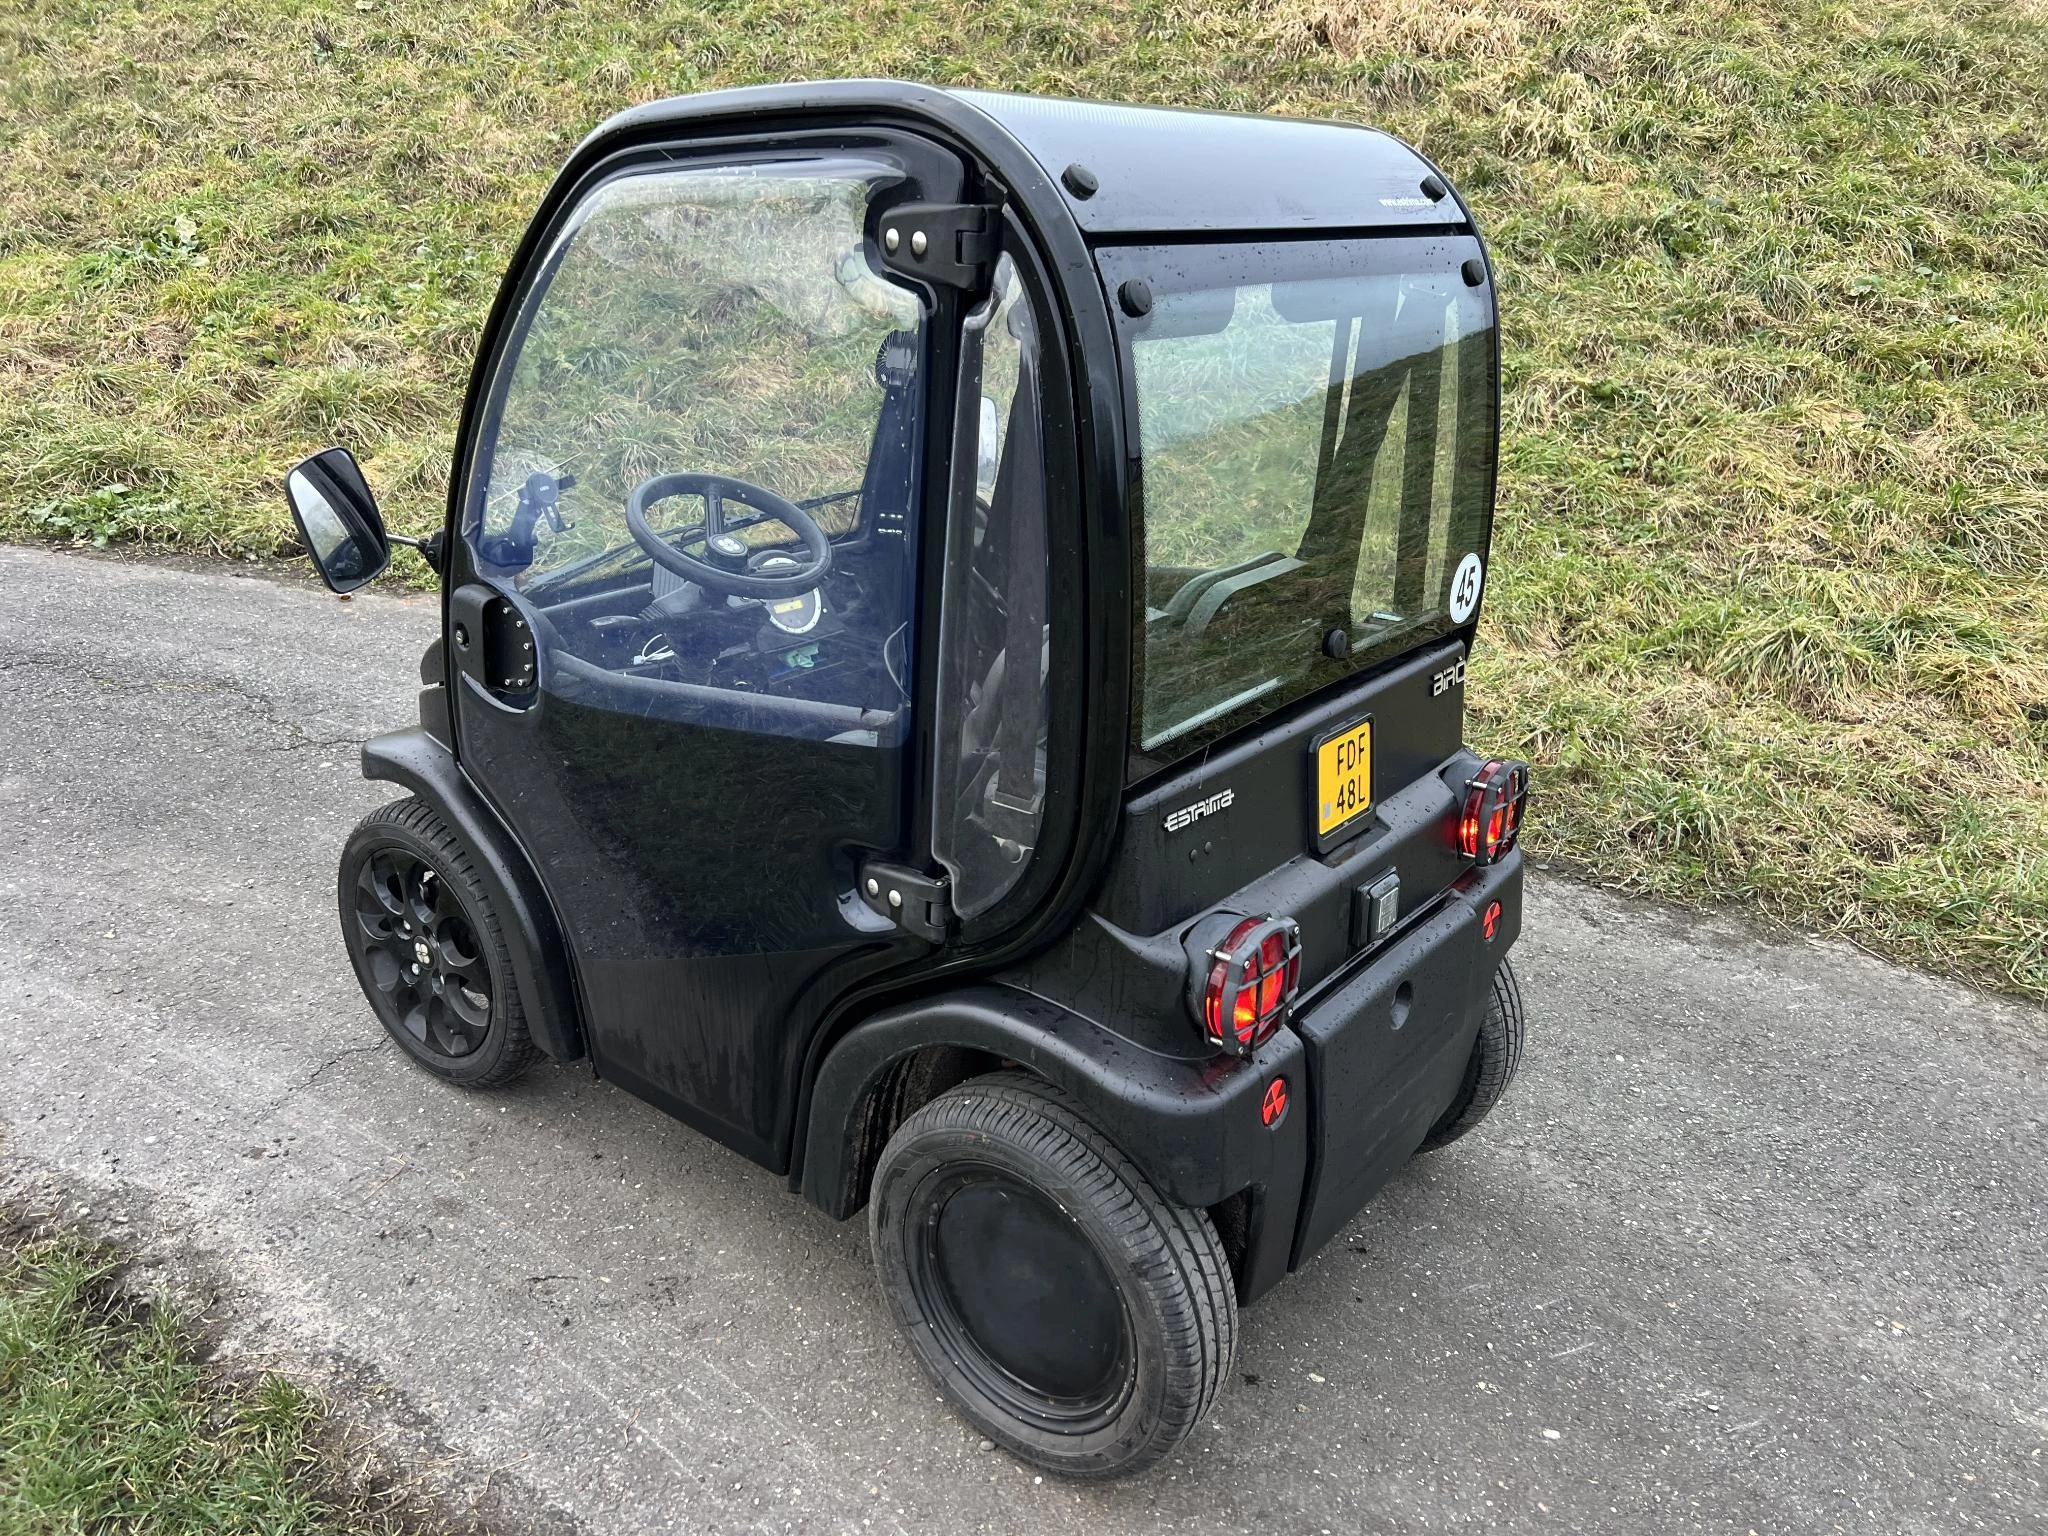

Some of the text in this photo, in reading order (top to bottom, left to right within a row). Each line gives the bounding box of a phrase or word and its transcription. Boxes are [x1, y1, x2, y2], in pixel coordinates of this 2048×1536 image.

[1456, 565, 1476, 610] 45
[1337, 732, 1366, 776] FDF
[1336, 774, 1366, 814] 48L
